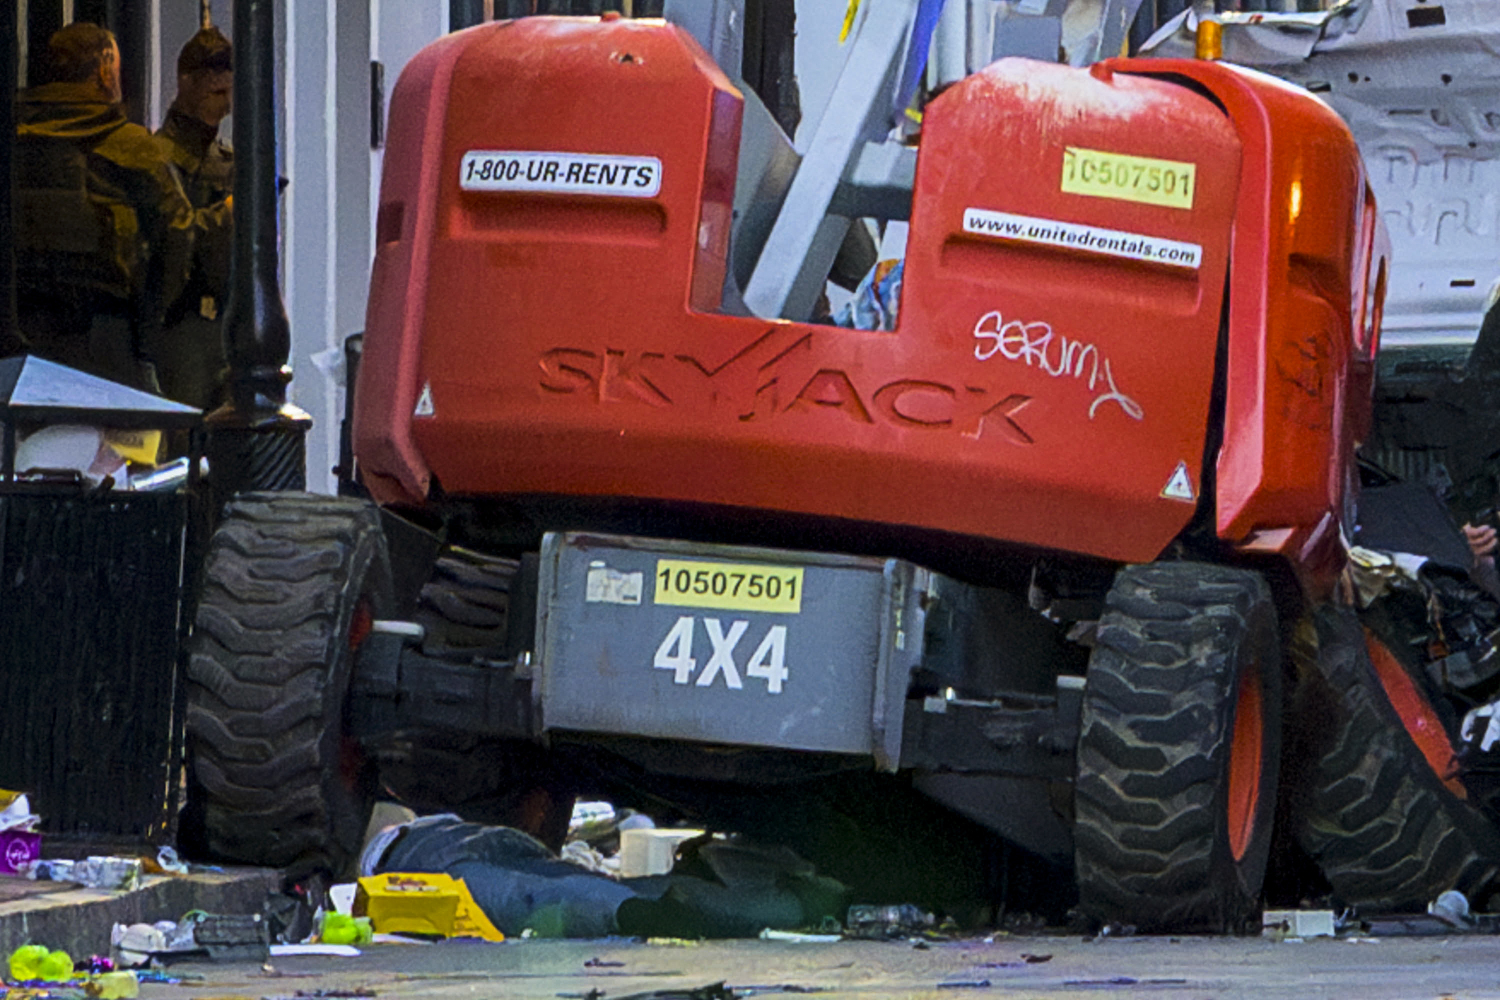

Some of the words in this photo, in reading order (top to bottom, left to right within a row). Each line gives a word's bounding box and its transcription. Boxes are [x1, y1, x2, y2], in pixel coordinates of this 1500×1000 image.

[466, 158, 654, 188] 1-800-UR-RENTS
[1066, 157, 1191, 198] 10507501
[969, 216, 1196, 264] www.unitedrentals.com
[539, 330, 1034, 444] SKYJACK
[658, 568, 799, 600] 10507501
[653, 616, 789, 694] 4X4
